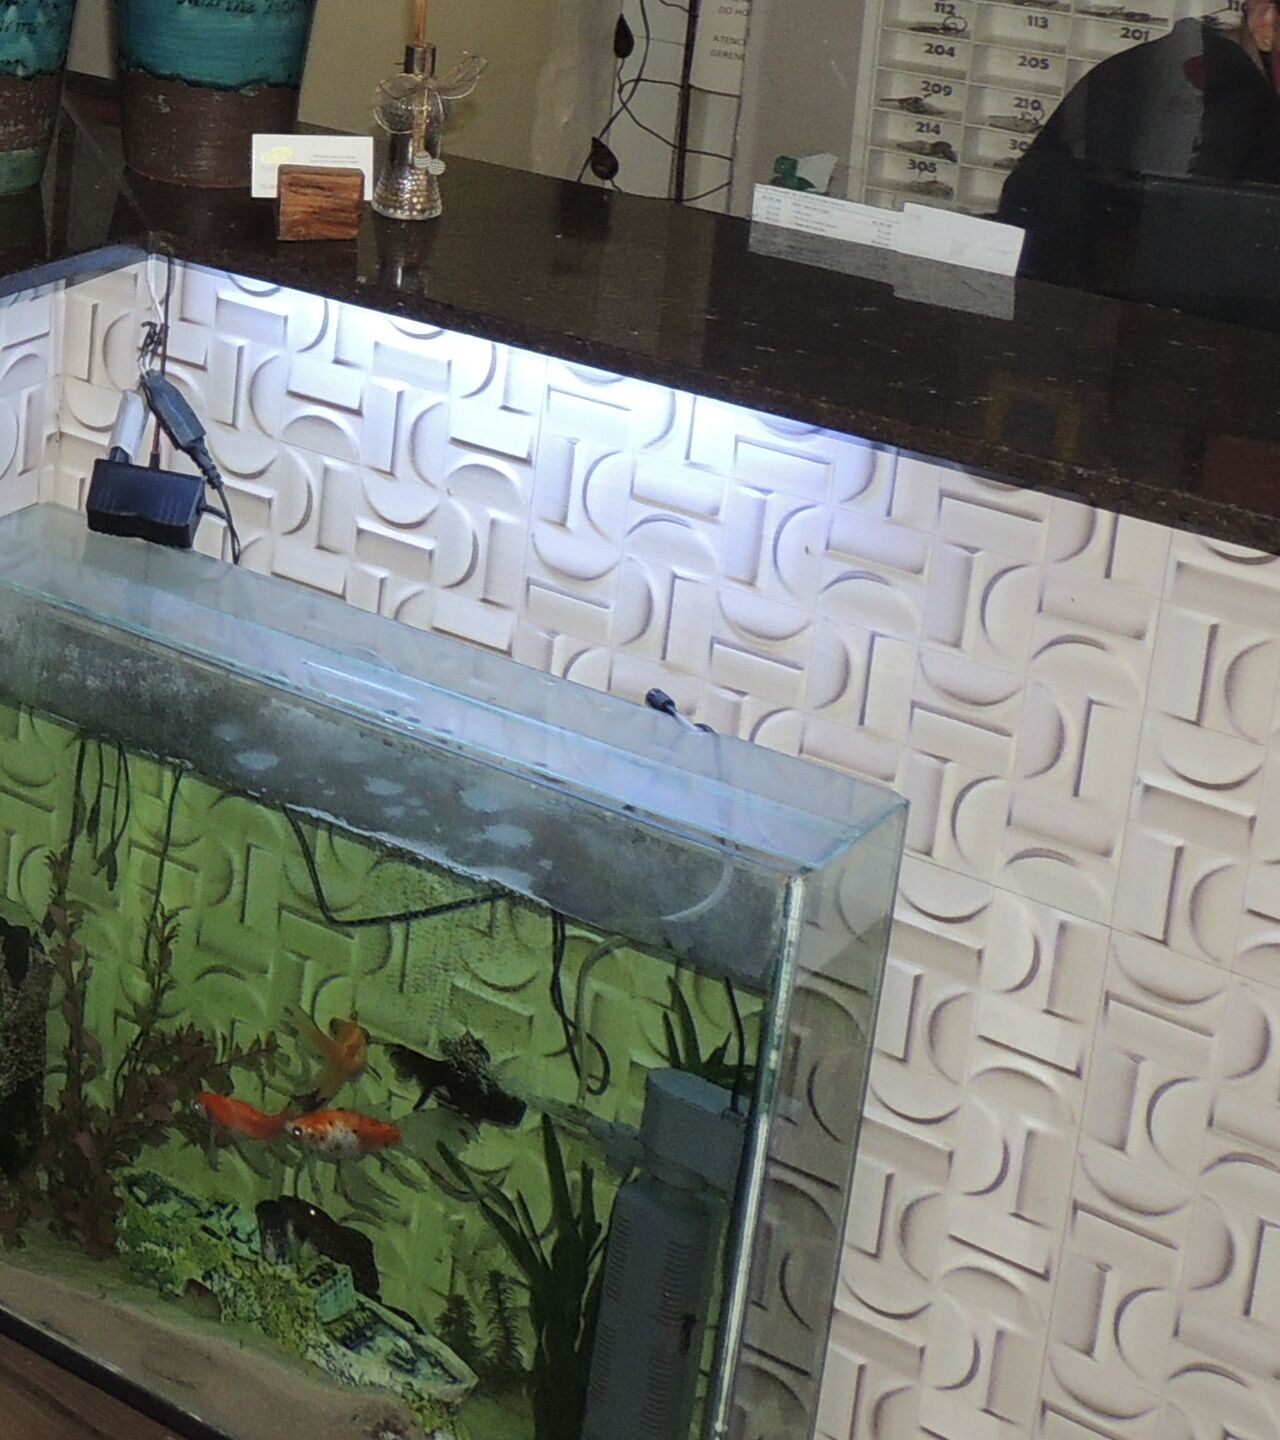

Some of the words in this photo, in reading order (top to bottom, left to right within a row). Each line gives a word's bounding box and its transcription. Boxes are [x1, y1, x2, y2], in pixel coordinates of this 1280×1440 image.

[934, 2, 956, 15] 112
[1027, 15, 1049, 29] 113
[1120, 27, 1150, 42] 201
[924, 43, 956, 57] 204
[1017, 55, 1049, 70] 205
[921, 80, 953, 96] 209
[1013, 96, 1042, 110] 210
[915, 122, 941, 136] 214
[1008, 138, 1030, 152] 30
[907, 159, 937, 173] 305
